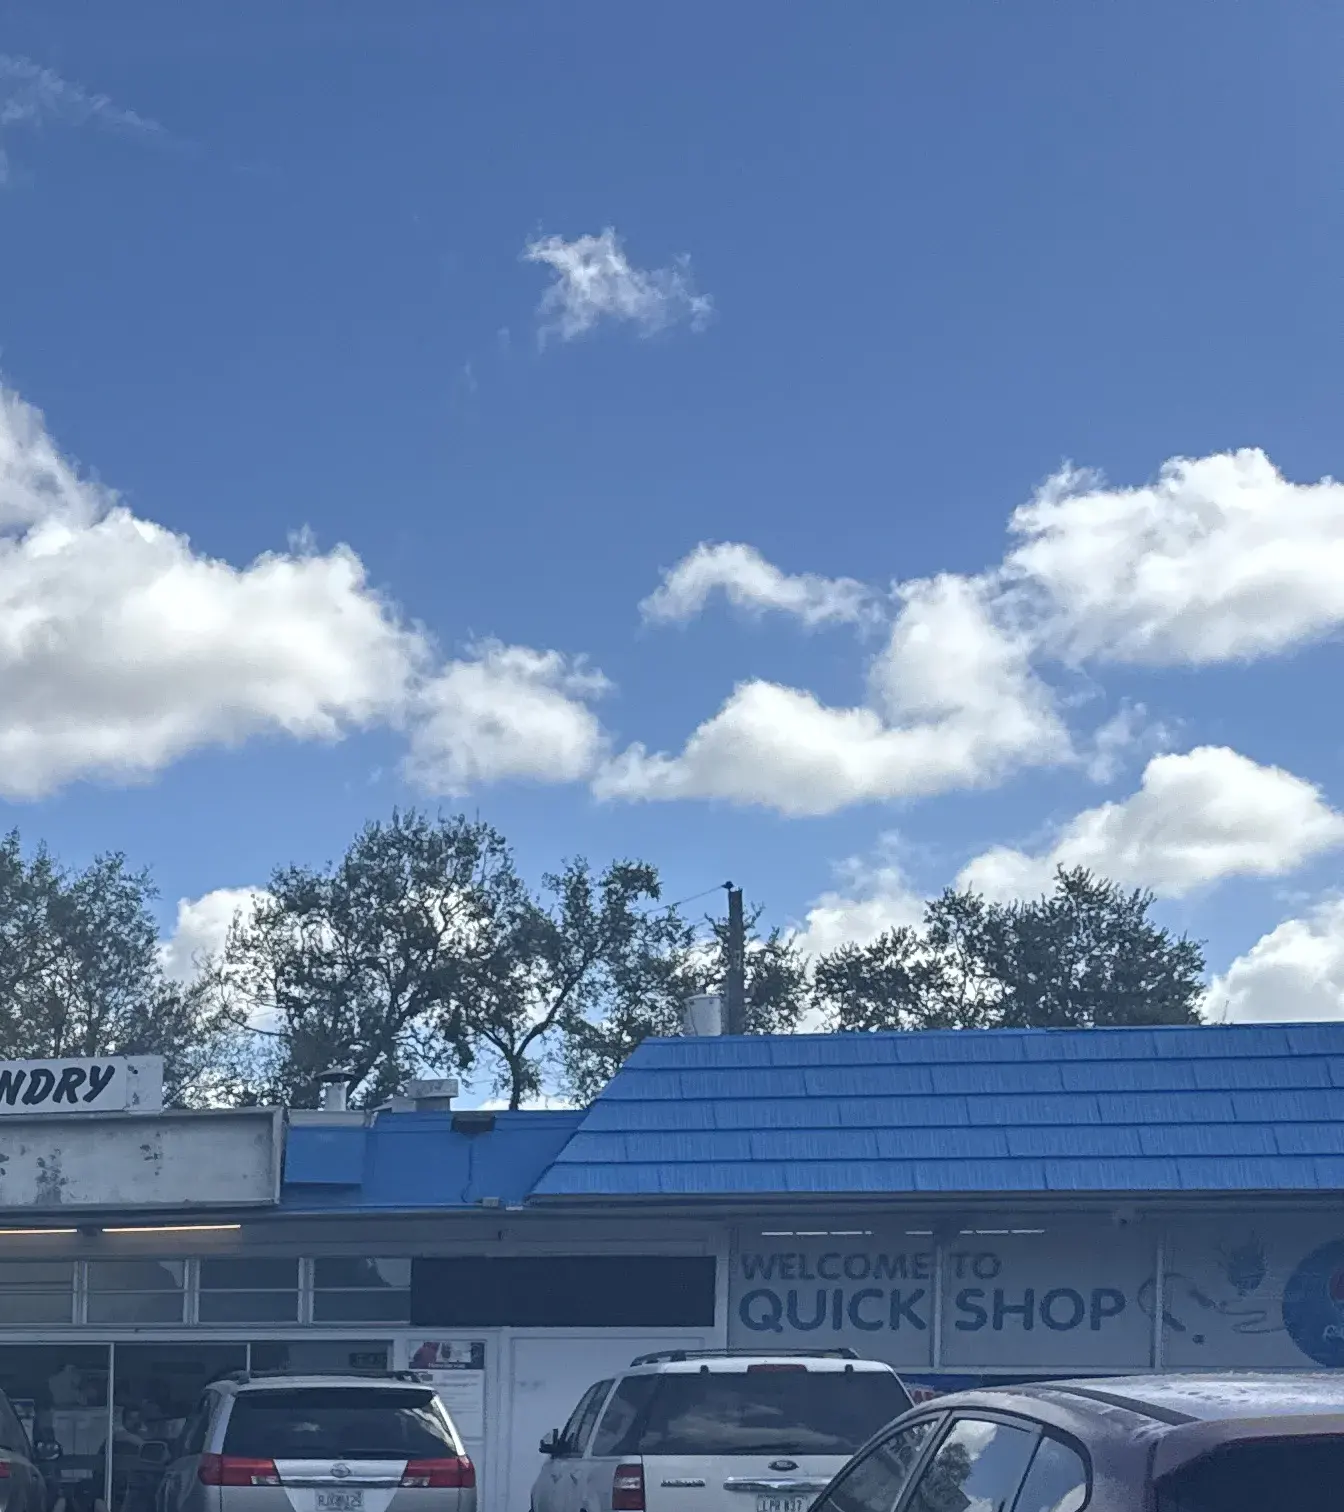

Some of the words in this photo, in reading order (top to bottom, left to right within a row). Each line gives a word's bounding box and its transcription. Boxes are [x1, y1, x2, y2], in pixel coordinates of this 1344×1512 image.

[741, 1252, 931, 1280] WELCOME
[948, 1252, 1002, 1280] TO
[739, 1288, 927, 1333] QUICK
[955, 1288, 1127, 1331] SHOP
